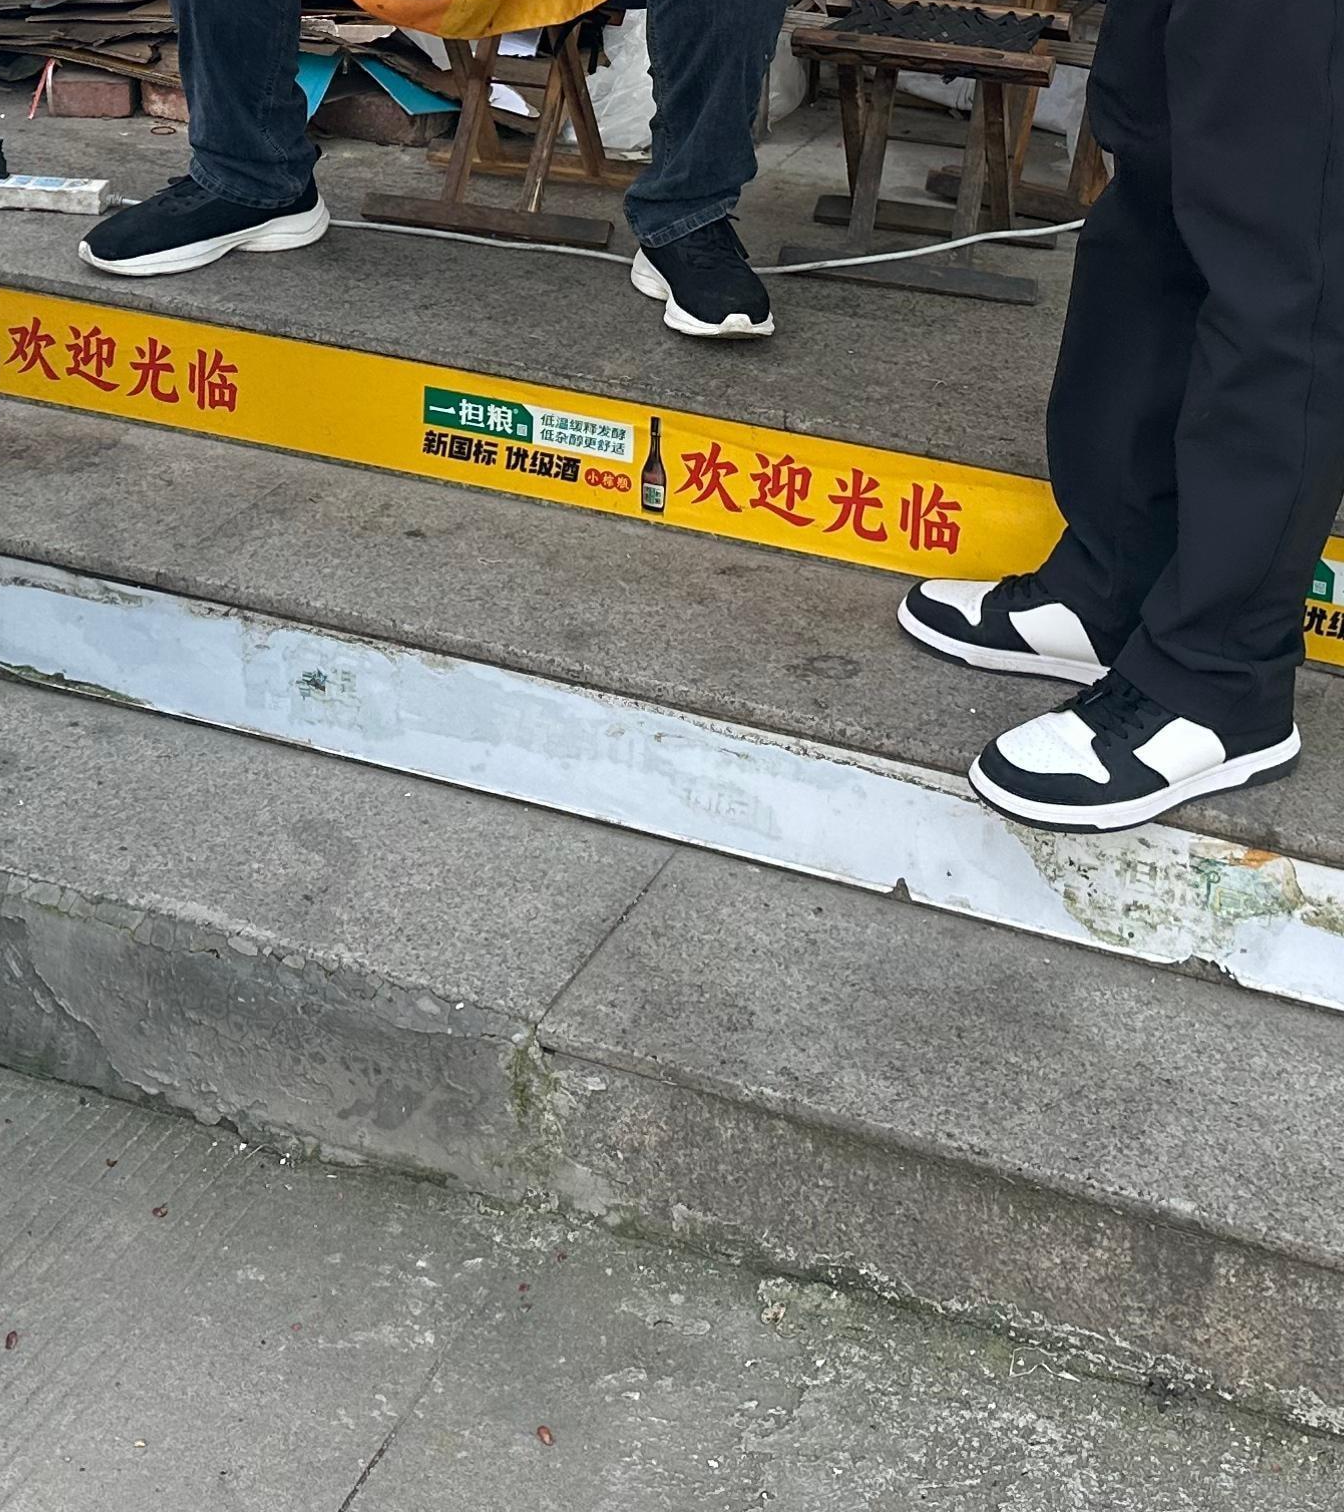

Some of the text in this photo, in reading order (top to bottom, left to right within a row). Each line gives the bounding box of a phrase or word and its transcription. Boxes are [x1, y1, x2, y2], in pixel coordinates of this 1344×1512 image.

[4, 317, 239, 413] 欢迎光临
[429, 398, 514, 434] 一担粮
[540, 413, 626, 441] 低温缓释发酵
[422, 430, 582, 483] 新国标 优级酒
[540, 428, 626, 456] 低杂醇更舒适
[674, 441, 963, 555] 欢迎光临
